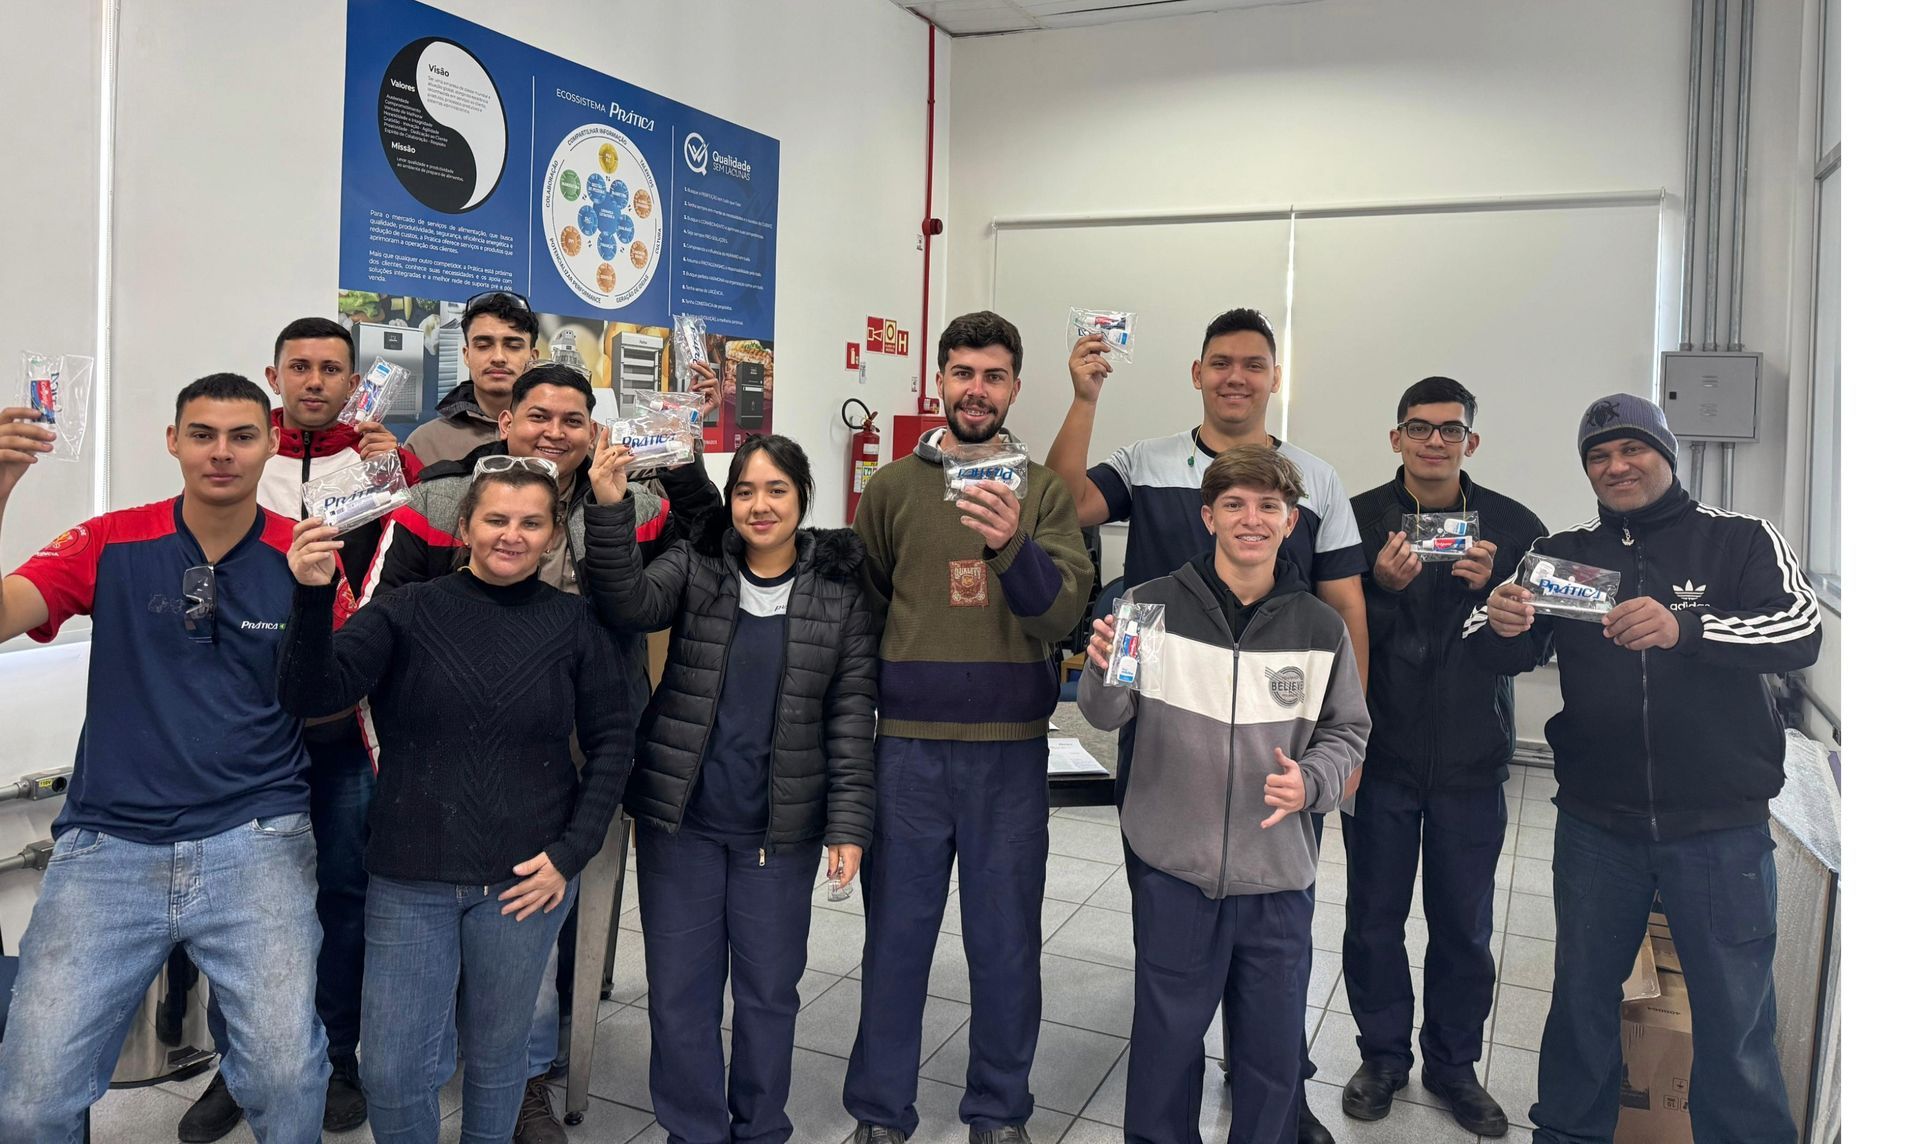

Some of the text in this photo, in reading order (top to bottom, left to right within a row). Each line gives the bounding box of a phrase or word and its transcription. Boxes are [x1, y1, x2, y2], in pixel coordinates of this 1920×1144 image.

[428, 64, 450, 77] Visão
[391, 78, 415, 92] Valores
[556, 88, 655, 131] ECOSSISTEMA PRÁTICA
[567, 128, 627, 146] COMPARTILHAR INFORMAÇÃO
[391, 141, 416, 154] Missão
[712, 151, 750, 172] Qualidade
[713, 162, 750, 181] SEM LACUNAS
[545, 160, 558, 208] COLABORAÇÃO
[370, 209, 383, 217] Para
[392, 215, 415, 223] mercado
[427, 221, 447, 229] serviços
[458, 227, 487, 237] alimentação,
[369, 227, 392, 235] redução
[401, 232, 419, 240] custos,
[424, 235, 441, 243] Prática
[442, 238, 460, 246] oferece
[461, 242, 479, 250] serviços
[484, 246, 504, 254] produtos
[370, 219, 398, 228] qualidade,
[399, 224, 435, 235] produtividade,
[436, 230, 462, 240] segurança,
[463, 235, 485, 243] eficiência
[486, 240, 509, 248] energética
[369, 235, 399, 244] aprimoram
[405, 240, 428, 249] operação
[439, 245, 458, 254] clientes.
[395, 254, 418, 262] qualquer
[434, 261, 462, 270] competidor,
[405, 264, 427, 272] conhece
[442, 269, 474, 278] necessidades
[368, 267, 392, 275] soluções
[394, 270, 421, 279] integradas
[898, 333, 907, 353] H
[1538, 578, 1601, 599] PRÁTICA
[241, 620, 278, 629] PRÁTICA
